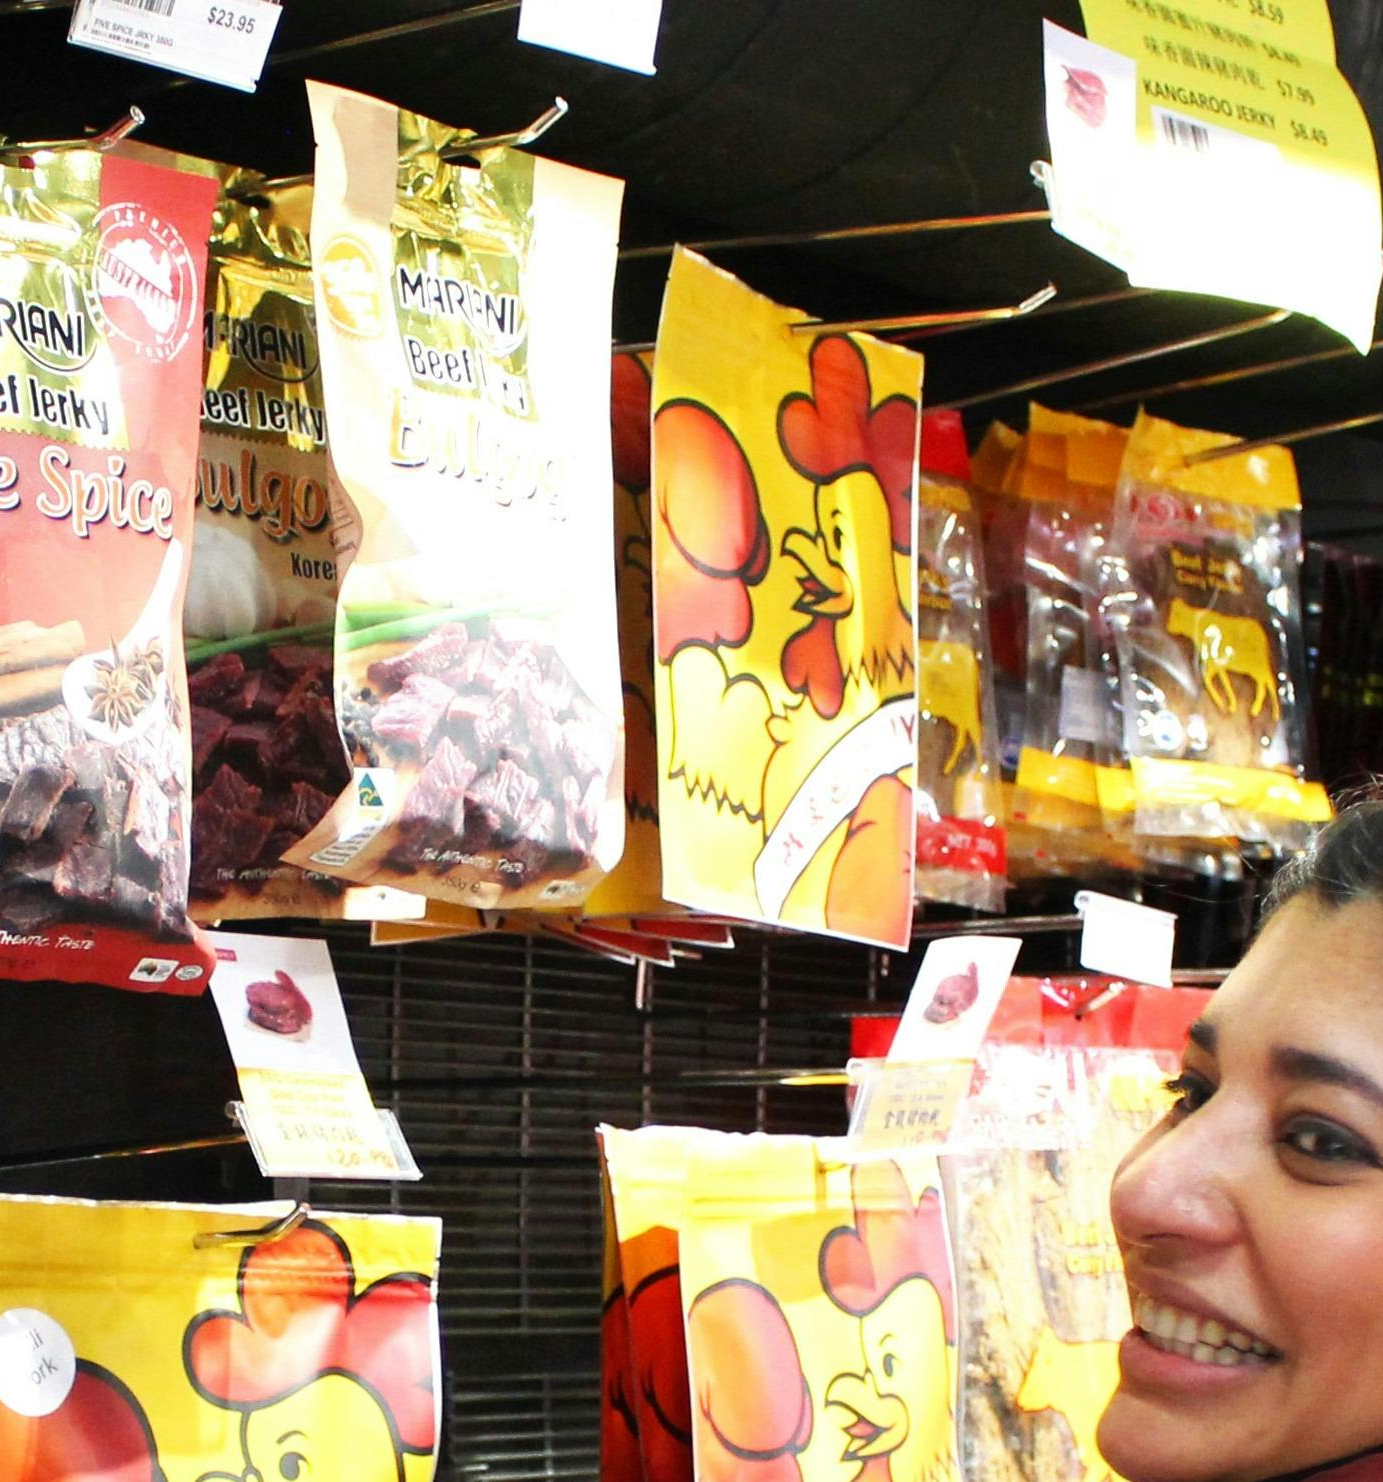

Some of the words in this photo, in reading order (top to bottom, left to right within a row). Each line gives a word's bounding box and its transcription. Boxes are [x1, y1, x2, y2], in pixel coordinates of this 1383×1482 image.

[207, 6, 257, 35] $23.95
[1142, 77, 1233, 118] KANGAROO
[1236, 102, 1277, 130] JERKY
[407, 339, 474, 386] Beef
[30, 378, 110, 436] Jerky
[200, 389, 250, 426] eef
[258, 390, 328, 443] Jerky
[35, 446, 174, 539] Spice
[196, 449, 330, 542] ulgo
[55, 935, 97, 951] TASTE
[31, 1359, 59, 1385] ork
